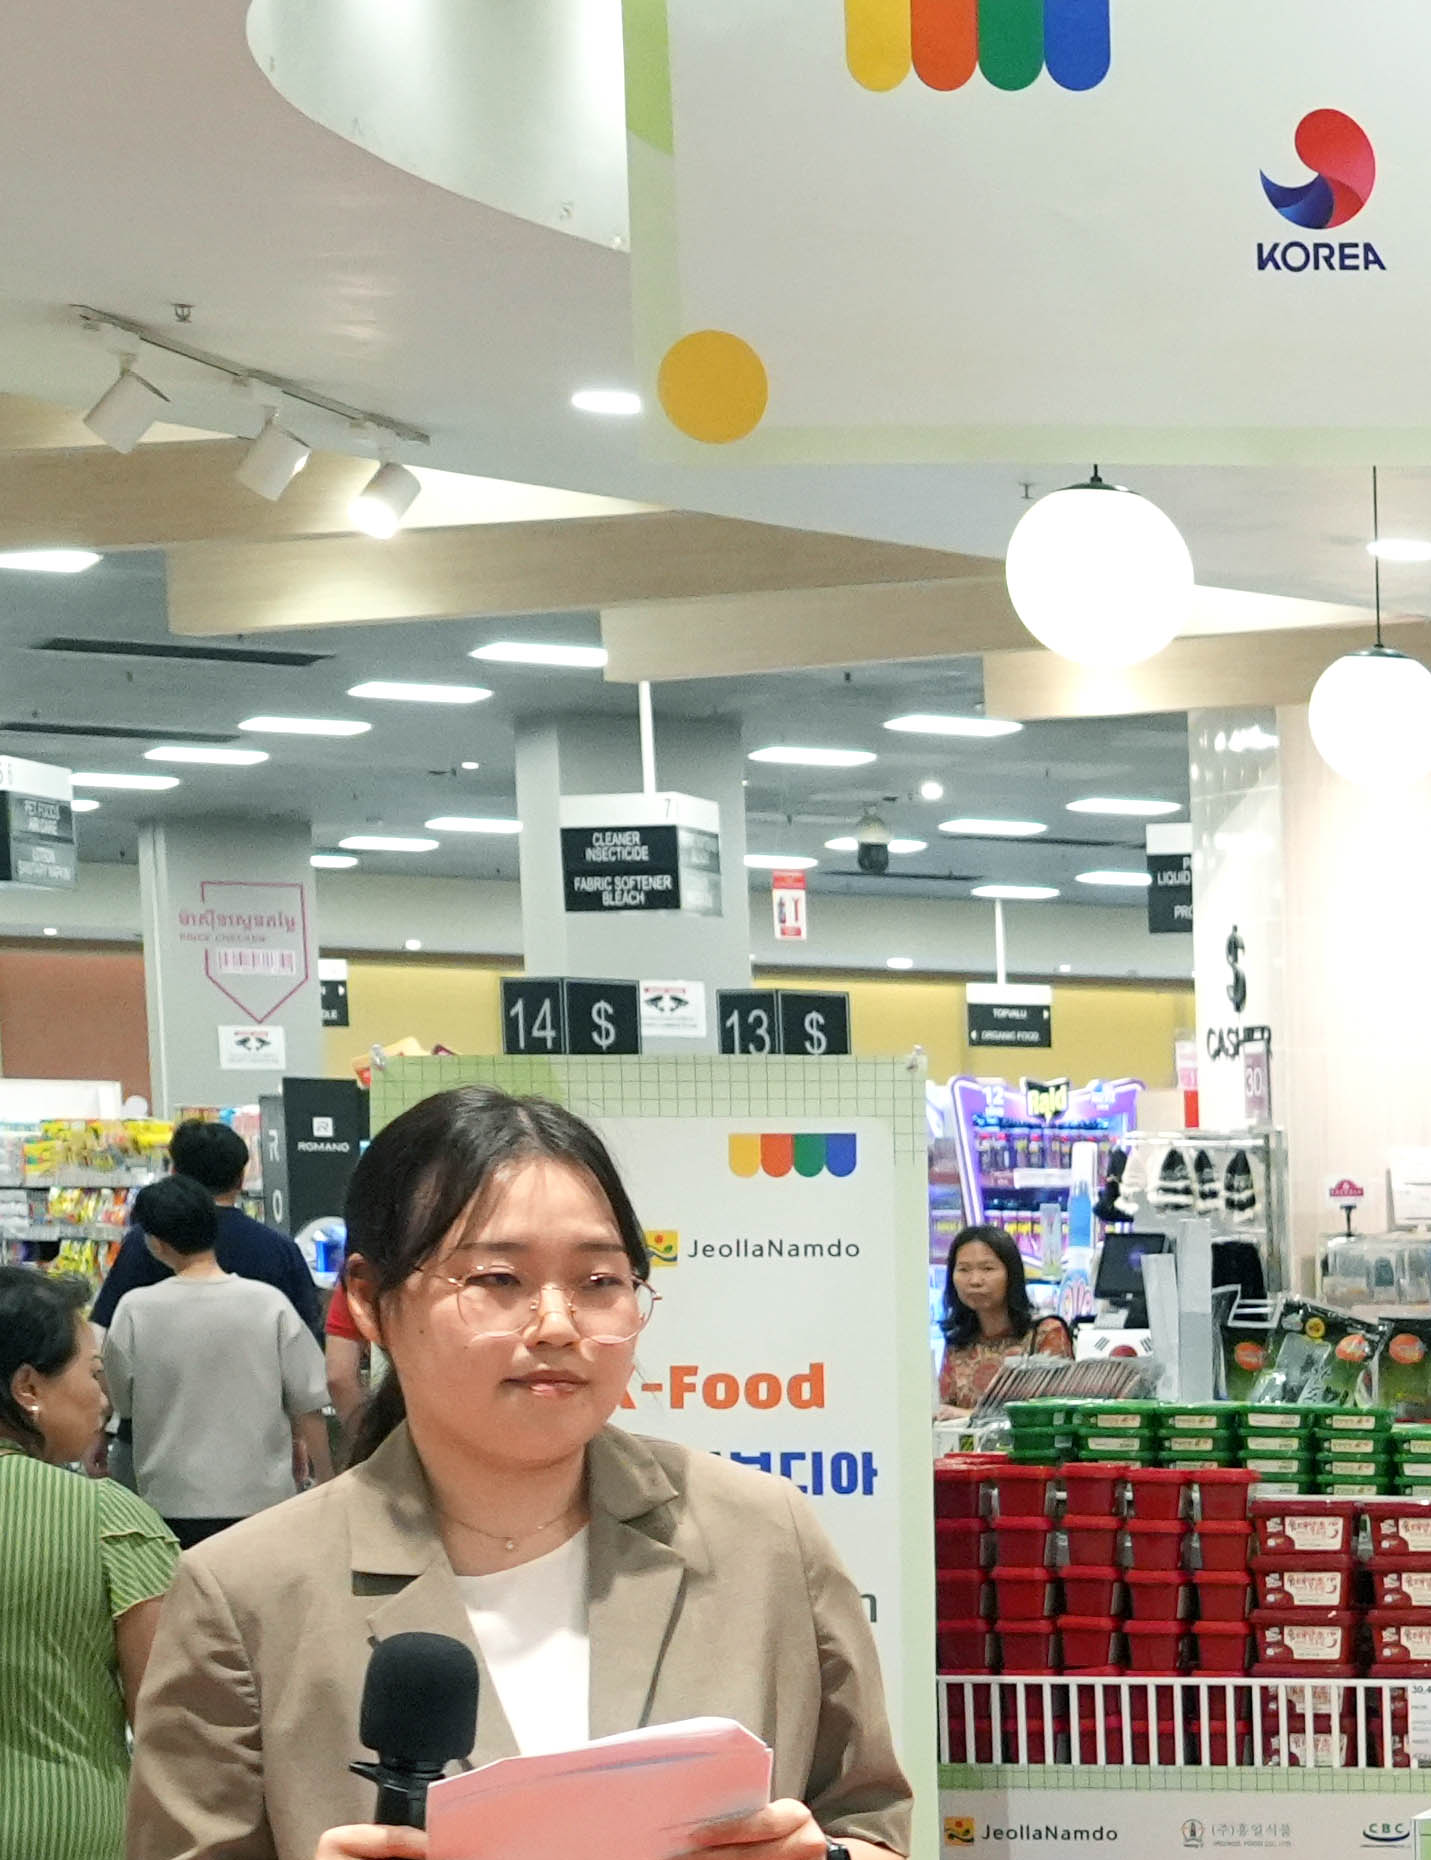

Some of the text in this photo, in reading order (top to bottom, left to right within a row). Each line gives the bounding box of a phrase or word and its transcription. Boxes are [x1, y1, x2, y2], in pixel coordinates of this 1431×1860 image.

[1256, 240, 1387, 273] KOREA
[592, 831, 641, 846] CLEANER
[584, 845, 650, 862] INSECTICIDE
[573, 875, 672, 892] FABRIC SOFTENER
[602, 890, 645, 905] BLEACH
[509, 998, 556, 1050] 14
[725, 1008, 772, 1055] 13
[297, 1141, 351, 1153] ROMANO
[688, 1237, 862, 1264] JeollaNamdo
[980, 1823, 1118, 1842] JeollaNamdo
[1368, 1822, 1405, 1836] CBC
